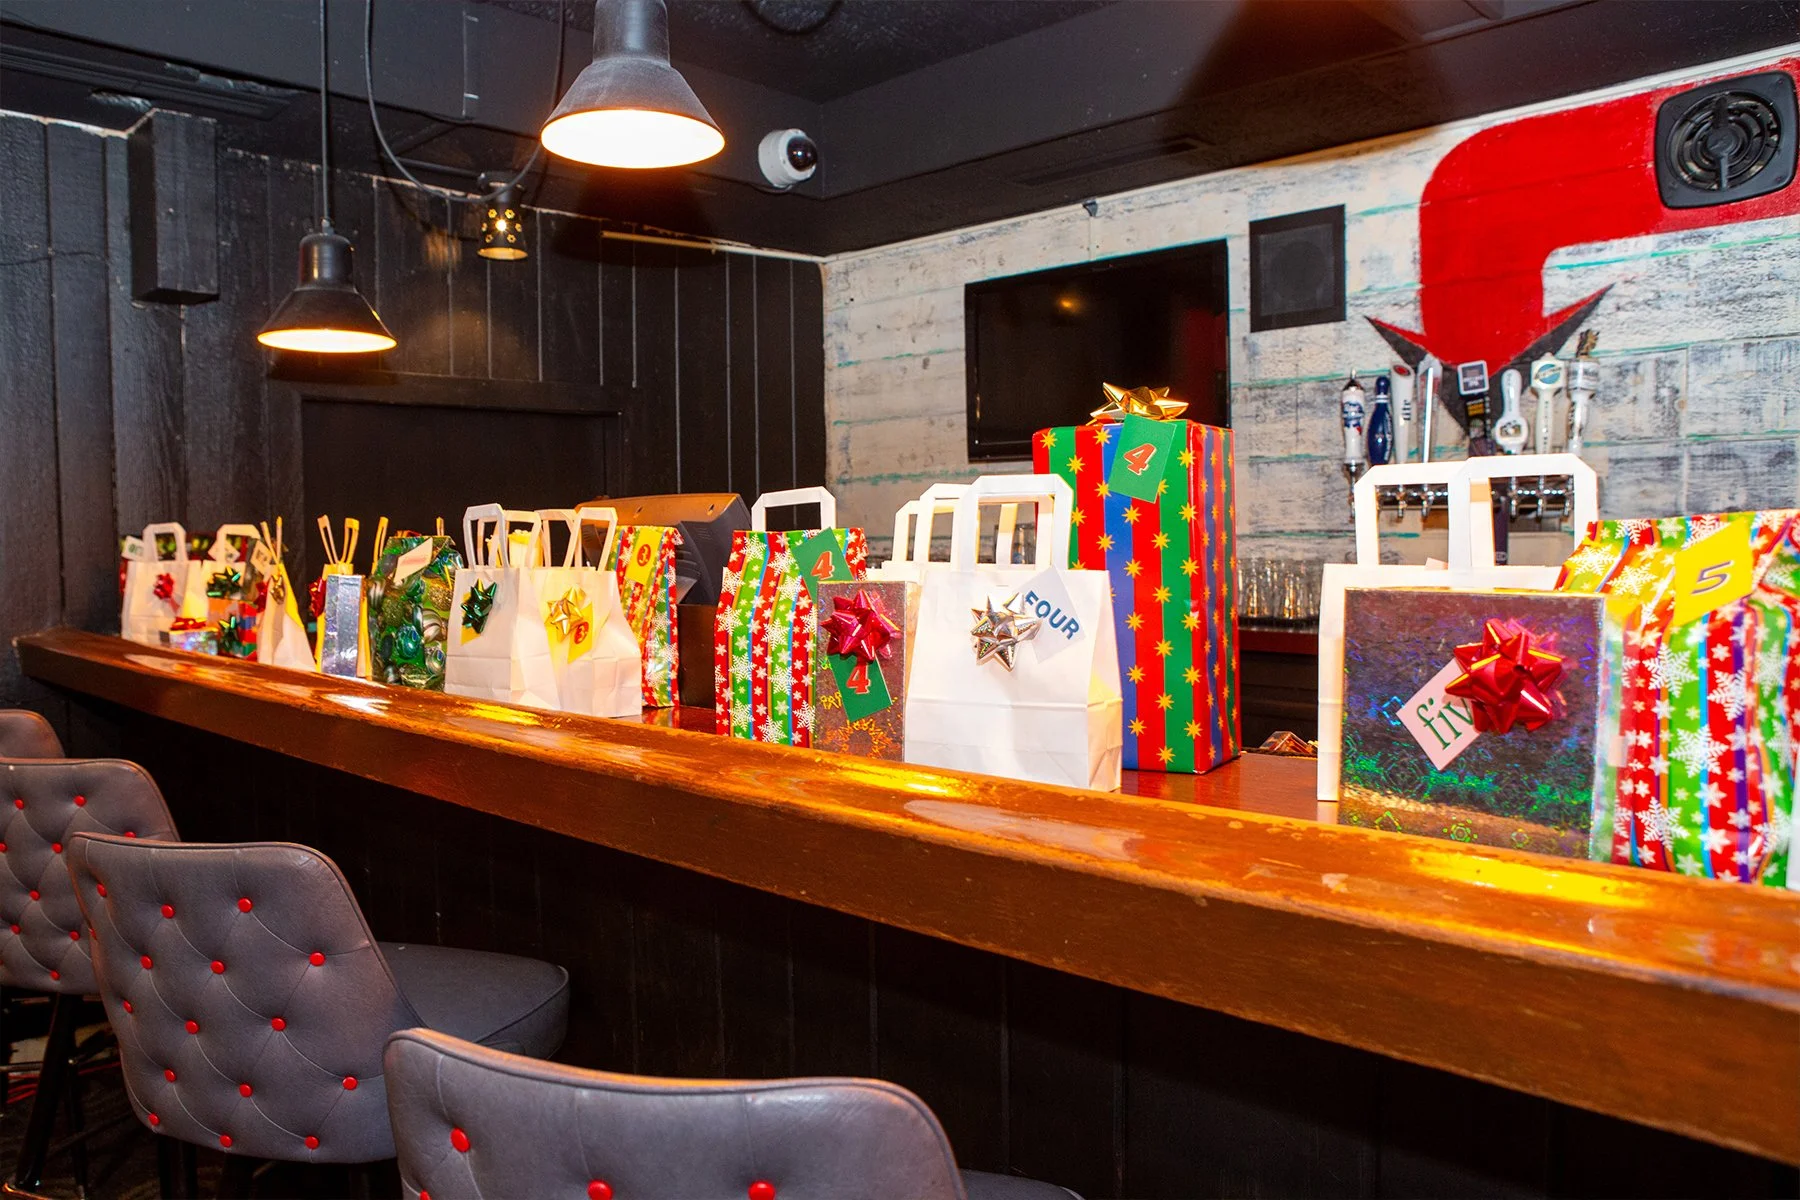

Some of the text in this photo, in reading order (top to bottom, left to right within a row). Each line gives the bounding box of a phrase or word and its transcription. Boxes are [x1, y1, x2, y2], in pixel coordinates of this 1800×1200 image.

[1123, 443, 1157, 476] 4
[810, 551, 835, 580] 4
[1690, 560, 1734, 596] 5
[1025, 590, 1080, 640] FOUR
[846, 662, 871, 695] 4
[1416, 697, 1474, 751] fiv
